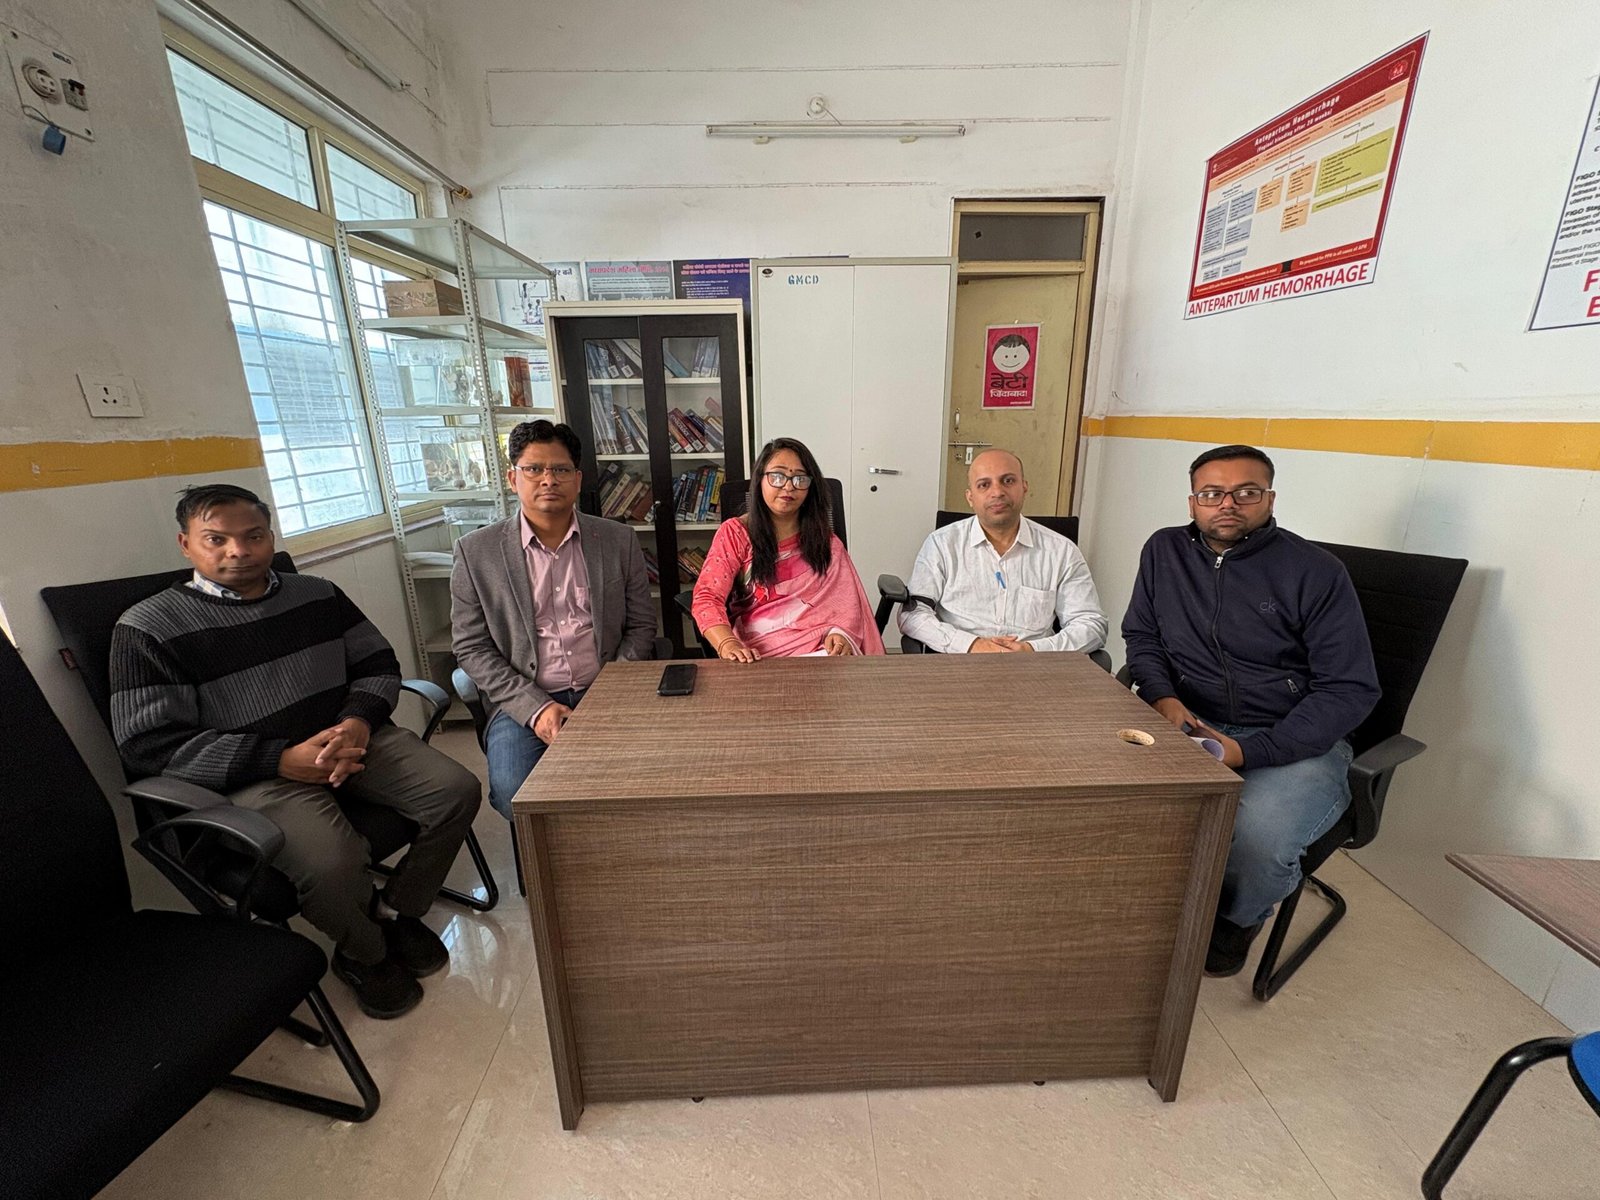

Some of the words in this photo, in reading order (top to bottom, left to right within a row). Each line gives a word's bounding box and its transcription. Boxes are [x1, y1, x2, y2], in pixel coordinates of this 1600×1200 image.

[1254, 123, 1291, 147] Antepartum
[1564, 207, 1585, 218] FIGO
[788, 274, 819, 285] GMCD
[1188, 288, 1260, 317] ANTEPARTUM
[1262, 261, 1370, 301] HEMORRHAGE
